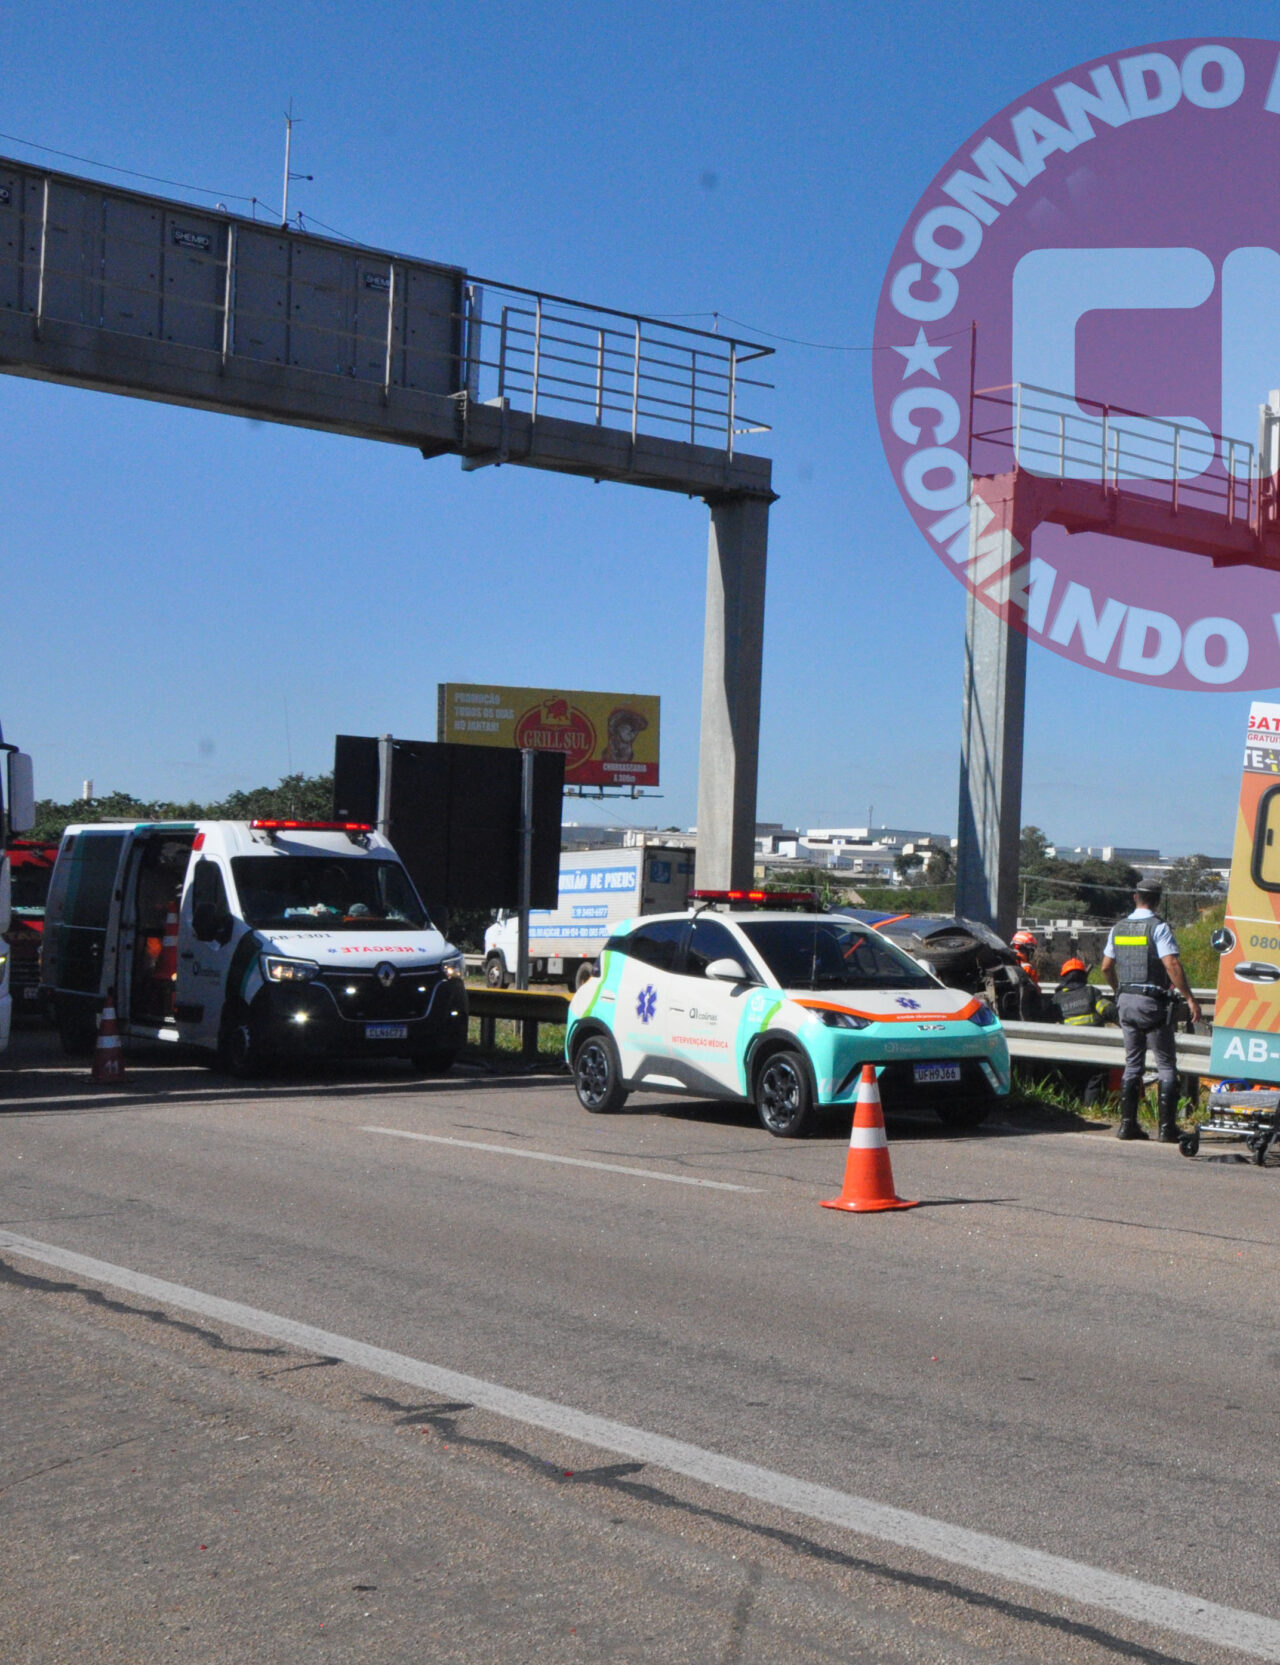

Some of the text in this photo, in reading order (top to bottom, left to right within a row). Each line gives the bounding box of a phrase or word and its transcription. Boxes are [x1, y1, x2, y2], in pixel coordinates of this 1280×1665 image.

[523, 730, 589, 750] GRILL SUL
[590, 873, 603, 889] DE
[604, 872, 636, 888] PNEUS
[672, 1035, 708, 1048] INTERVENÇÃO
[708, 1038, 729, 1049] MÉDICA
